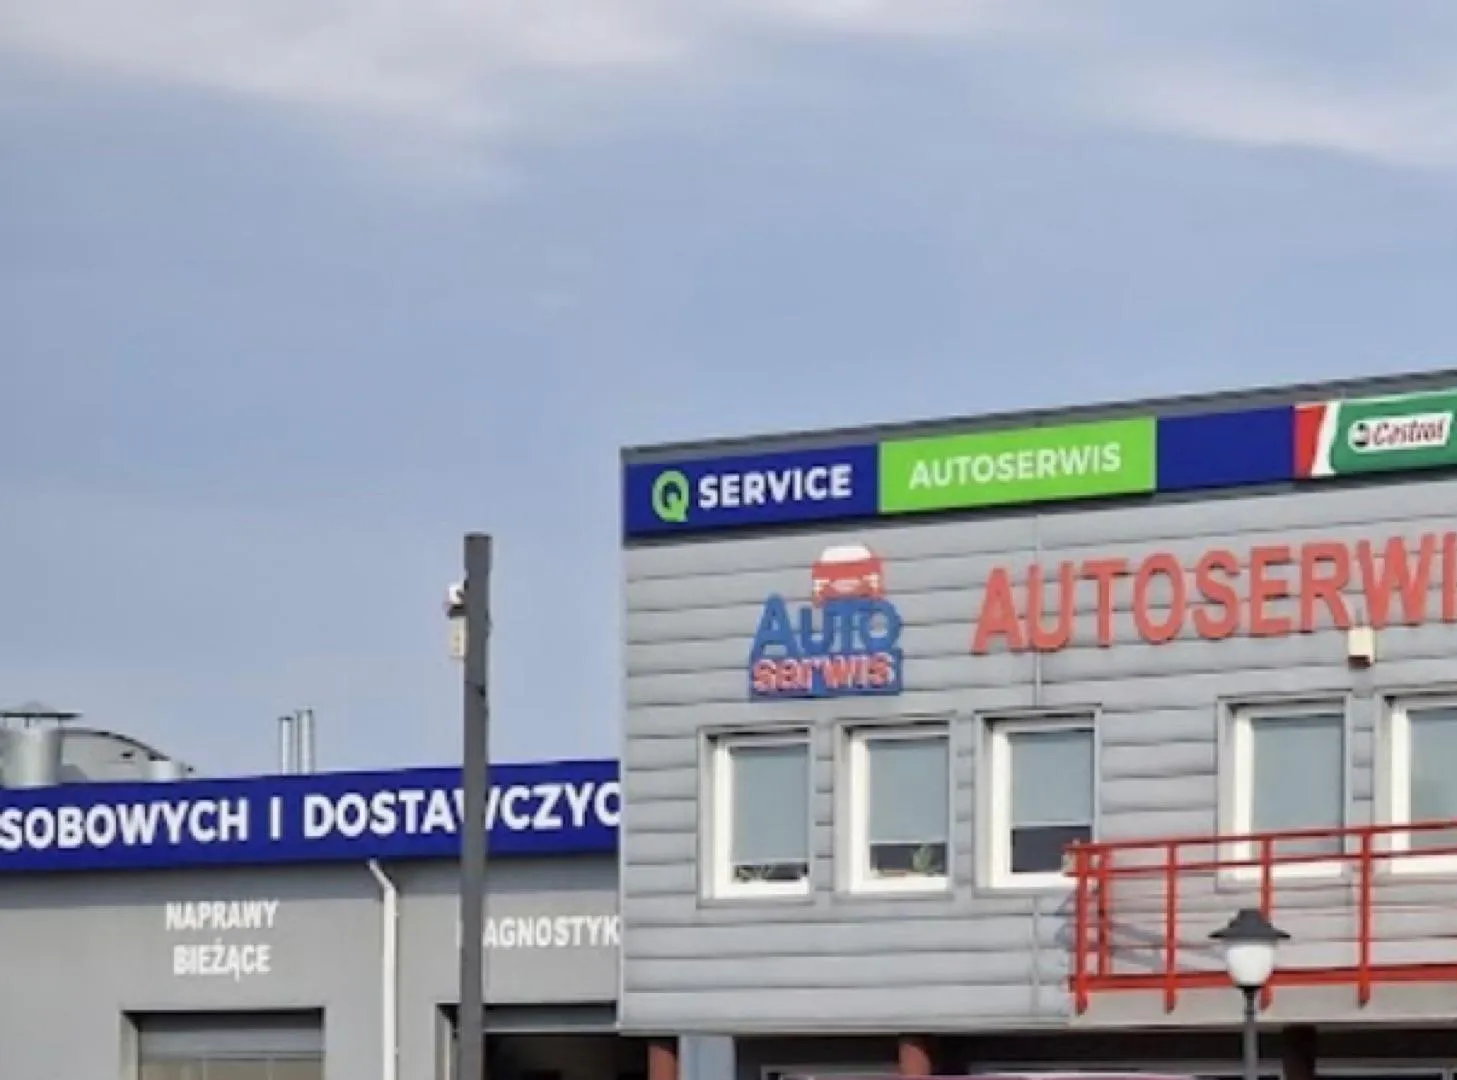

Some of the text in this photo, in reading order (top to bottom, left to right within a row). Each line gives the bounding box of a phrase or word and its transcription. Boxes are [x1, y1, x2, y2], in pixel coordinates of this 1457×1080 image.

[1372, 419, 1445, 446] Castrol
[698, 465, 853, 509] SERVICE
[908, 442, 1122, 490] AUTOSERWIS
[0, 798, 249, 851] SOBOWYCH
[270, 796, 283, 841] I
[165, 898, 280, 931] NAPRAWY
[457, 914, 620, 948] AGNOSTYK
[173, 937, 272, 983] BIEŻĄCE
